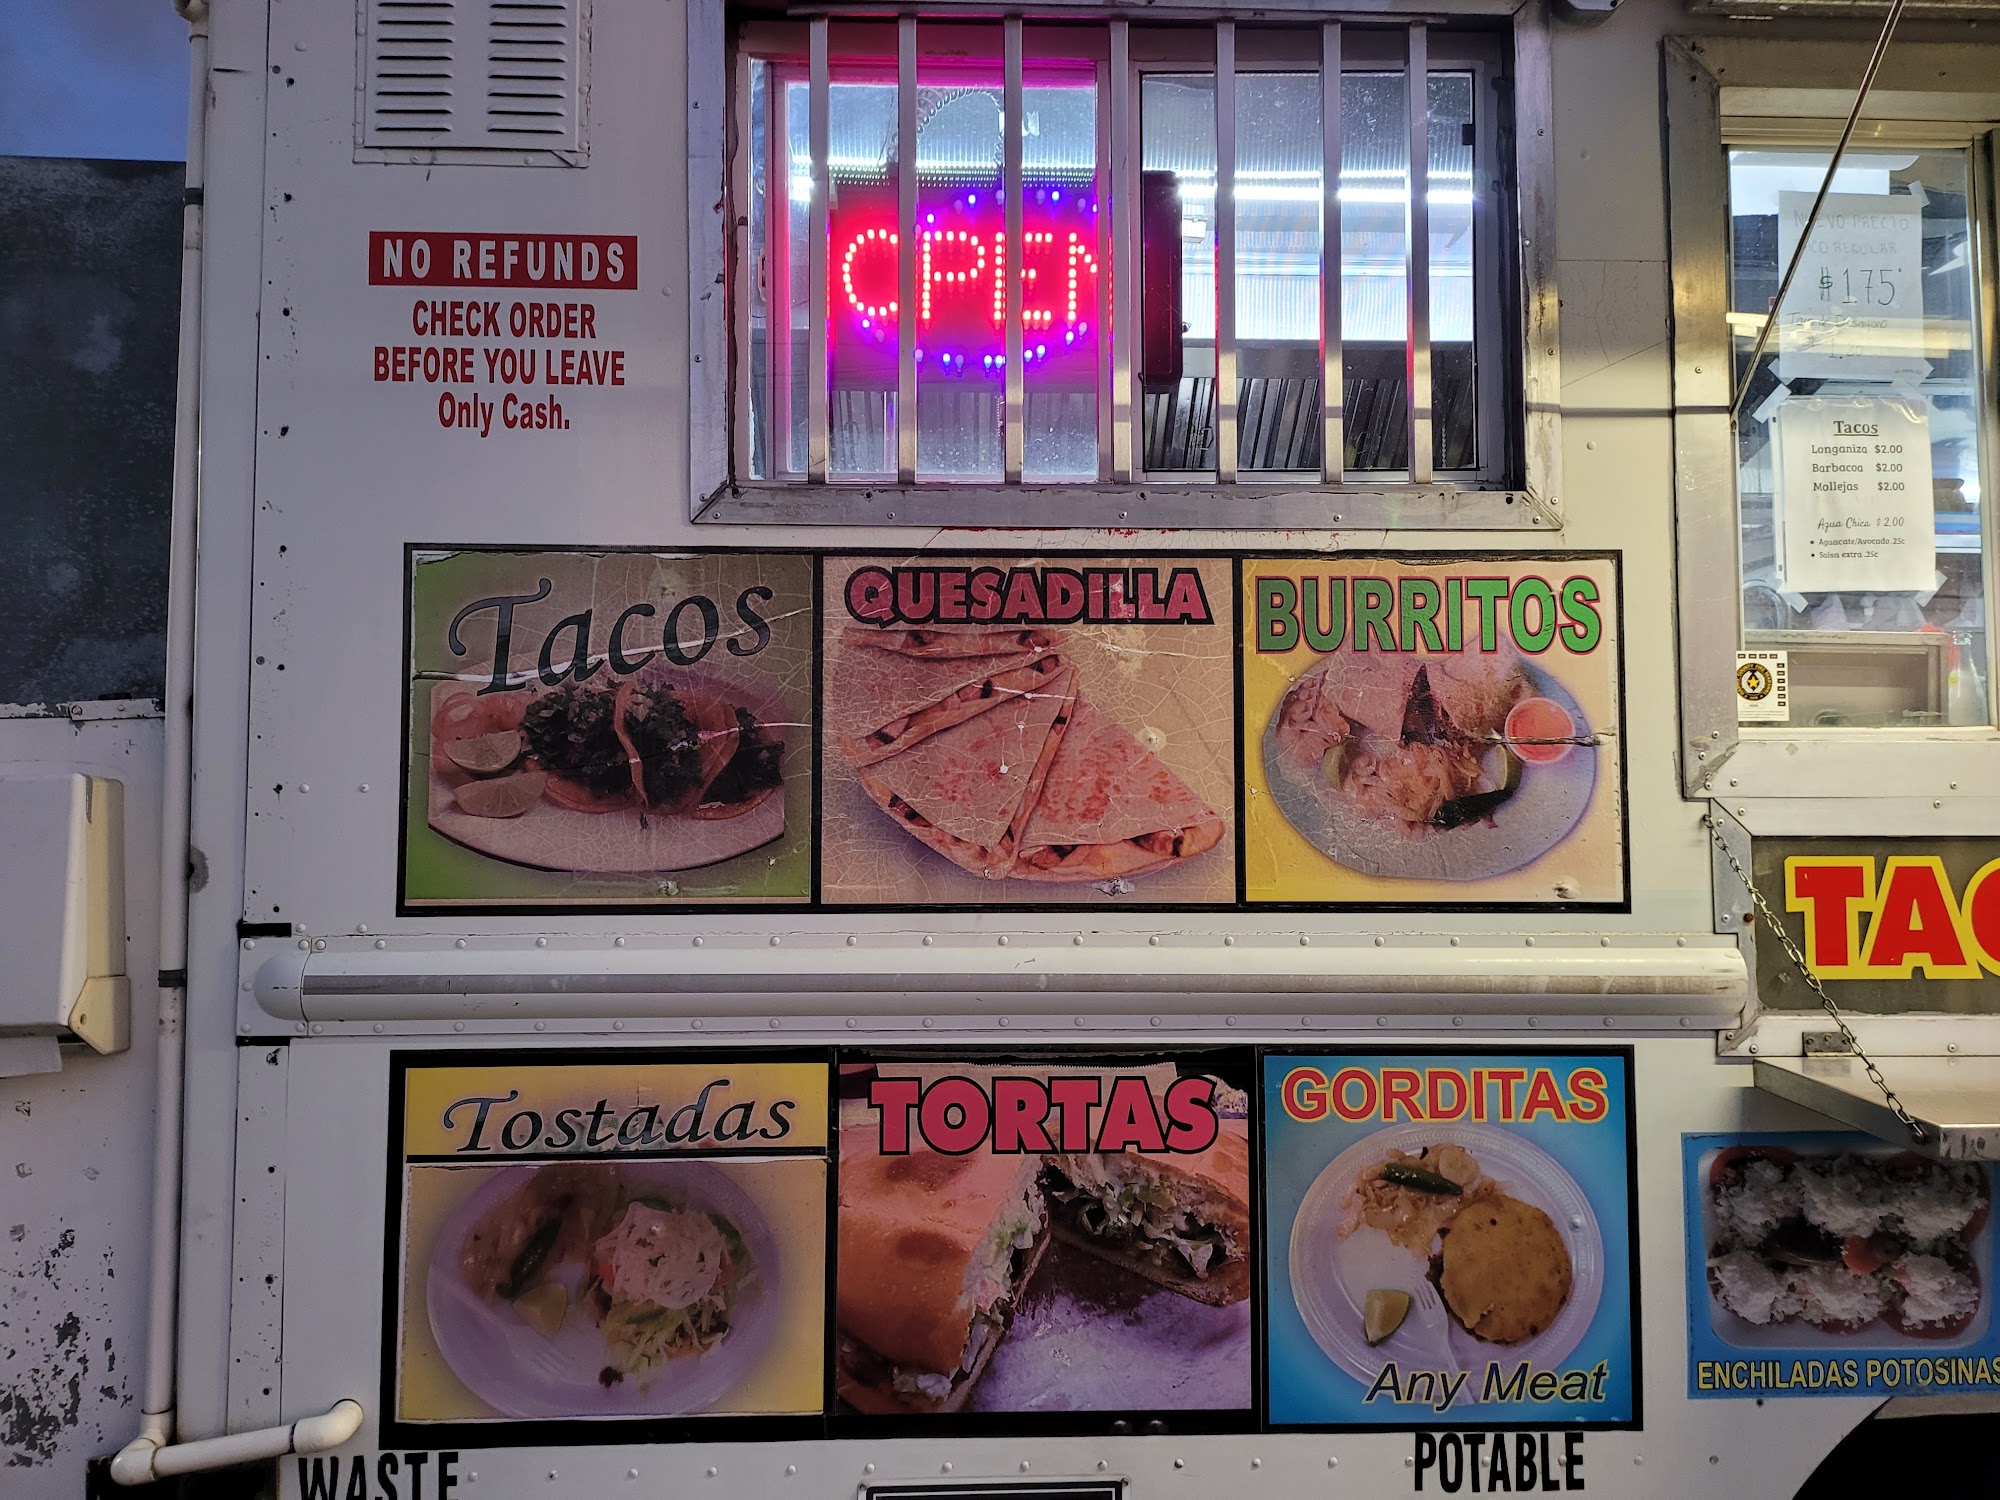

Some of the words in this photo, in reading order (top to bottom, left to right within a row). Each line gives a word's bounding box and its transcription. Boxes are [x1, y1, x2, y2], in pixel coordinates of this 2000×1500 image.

[1794, 210, 1845, 229] NEVO
[383, 239, 431, 278] NO
[453, 240, 625, 282] REFUNDS
[412, 300, 501, 337] CHECK
[510, 302, 597, 339] ORDER
[374, 346, 474, 383] BEFORE
[483, 348, 535, 384] YOU
[546, 349, 625, 386] LEAVE
[438, 391, 494, 438] Only
[502, 392, 570, 430] Cash.
[1833, 420, 1879, 434] Tacos
[1811, 444, 1868, 456] Longaniza
[1874, 444, 1903, 455] $2.00
[1812, 463, 1864, 473] Barbacoa
[1875, 463, 1903, 473] $2.00
[1813, 482, 1859, 494] Mollejas
[1877, 481, 1905, 492] $2.00
[1818, 517, 1843, 534] Agua
[1819, 551, 1840, 559] Salsa
[844, 565, 1215, 629] QUESADILLA
[1255, 575, 1603, 655] BURRITOS
[448, 577, 774, 697] Tacos
[443, 1079, 797, 1153] Tostadas
[867, 1075, 1219, 1156] TORTAS
[1281, 1067, 1609, 1124] GORDITAS
[1363, 1359, 1471, 1413] Any
[1480, 1358, 1609, 1404] Meat
[1697, 1360, 1859, 1390] ENCHILADAS
[298, 1452, 459, 1500] WASTE
[1414, 1432, 1585, 1493] POTABLE
